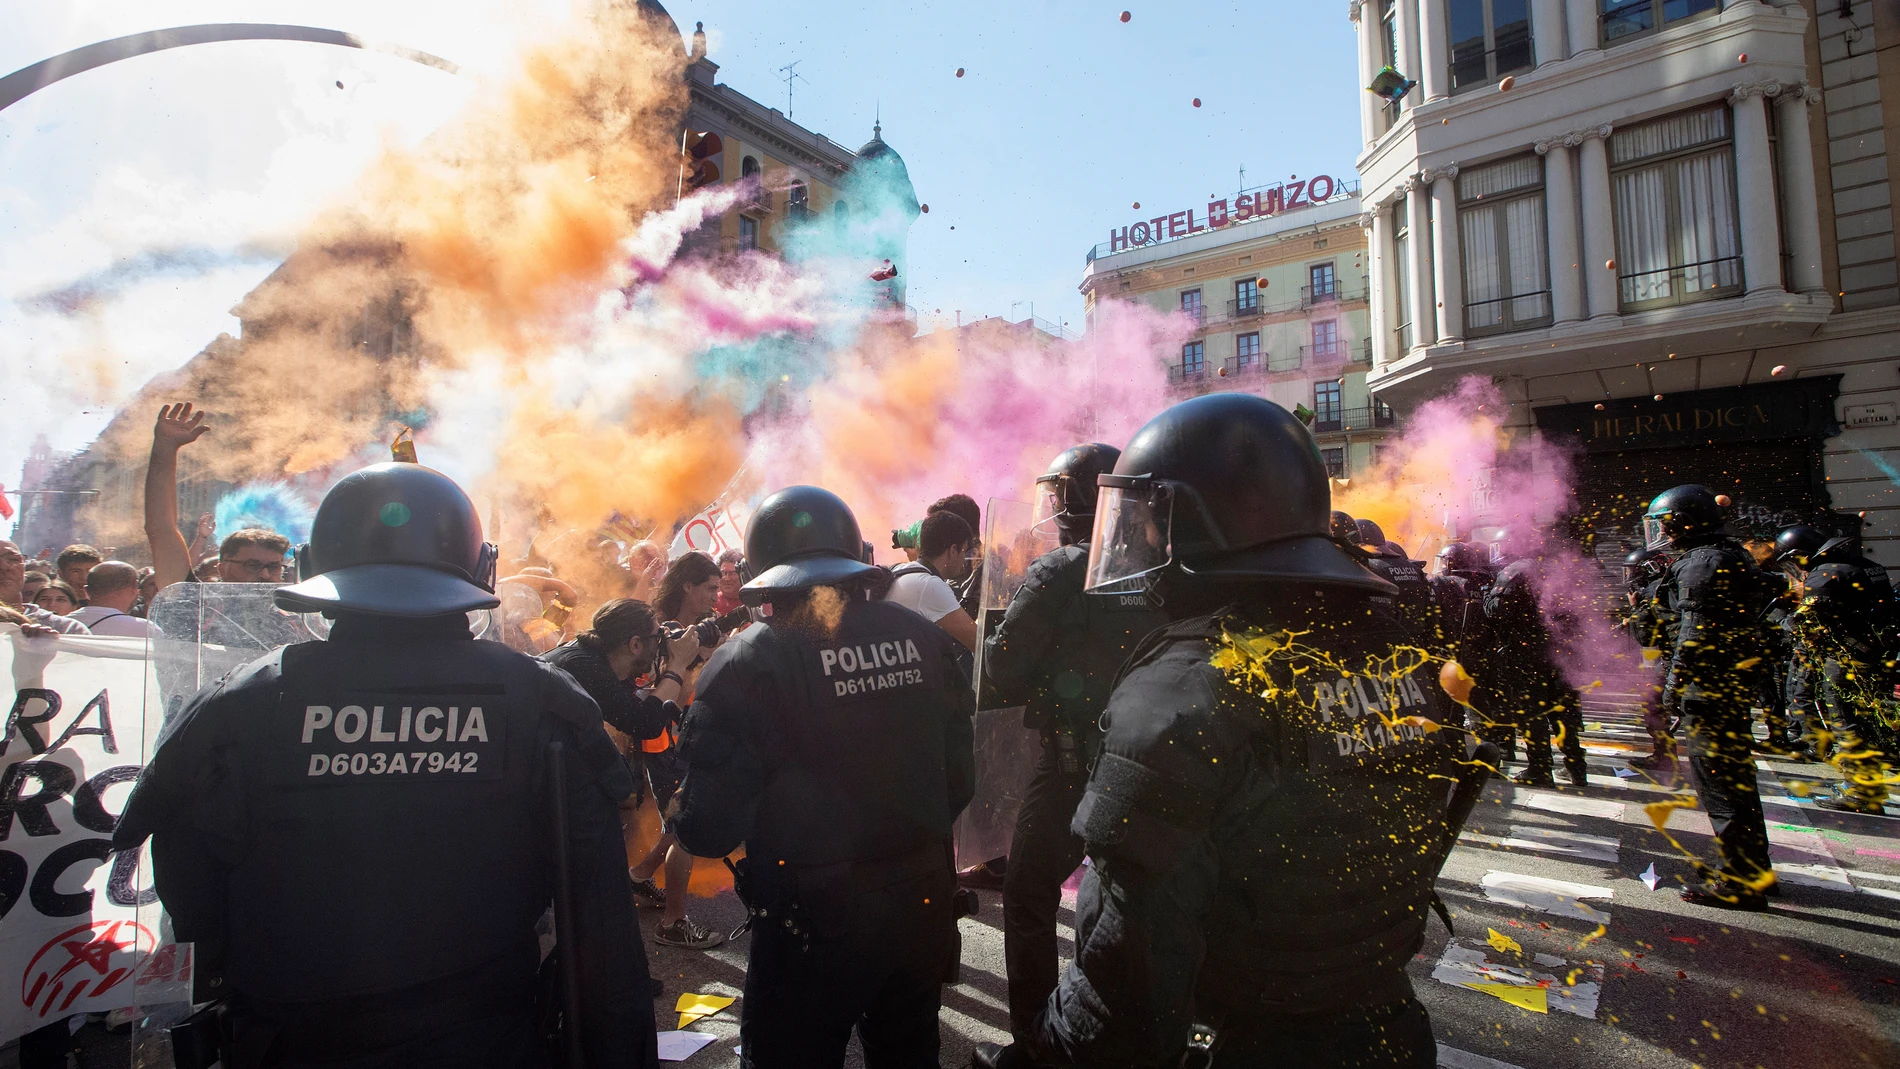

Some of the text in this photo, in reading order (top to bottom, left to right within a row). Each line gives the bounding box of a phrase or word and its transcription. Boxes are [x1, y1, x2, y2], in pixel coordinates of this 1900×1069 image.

[1110, 174, 1335, 252] HOTEL SUIZO
[1593, 404, 1769, 438] HERALDICA
[1853, 415, 1889, 425] LAIETANA
[1388, 566, 1418, 576] POLICIA
[820, 638, 922, 677] POLICIA
[834, 669, 923, 698] D611A8752
[1313, 671, 1427, 723] POLICIA
[0, 687, 119, 755] RA
[301, 705, 489, 744] POLICIA
[307, 752, 479, 776] D603A7942
